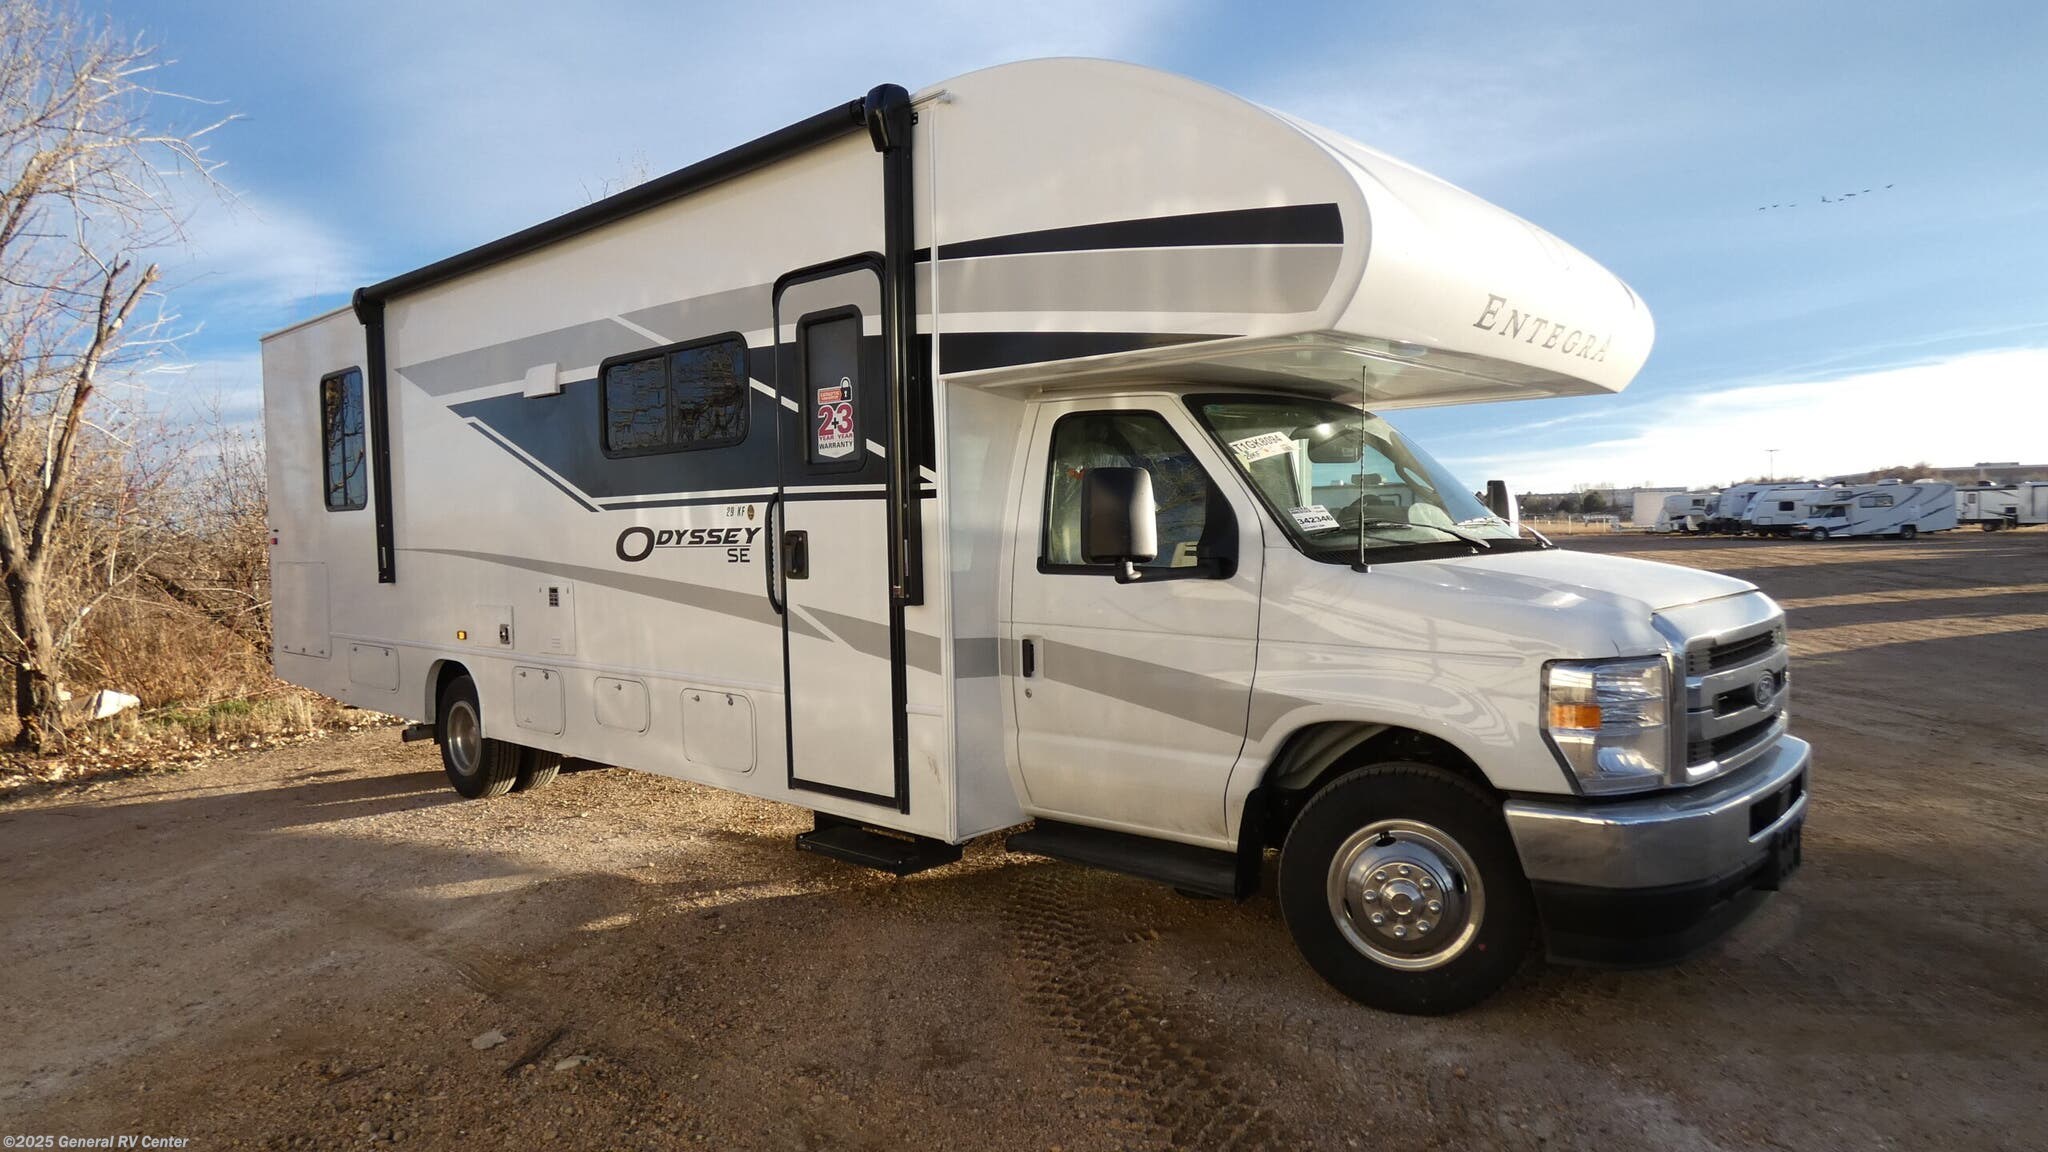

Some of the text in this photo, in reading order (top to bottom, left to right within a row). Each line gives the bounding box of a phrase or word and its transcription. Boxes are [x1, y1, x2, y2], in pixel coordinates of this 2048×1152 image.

[1472, 293, 1612, 362] ENTEGRA
[819, 441, 853, 450] WARRANTY
[616, 526, 762, 563] ODYSSEY
[727, 548, 751, 563] SE
